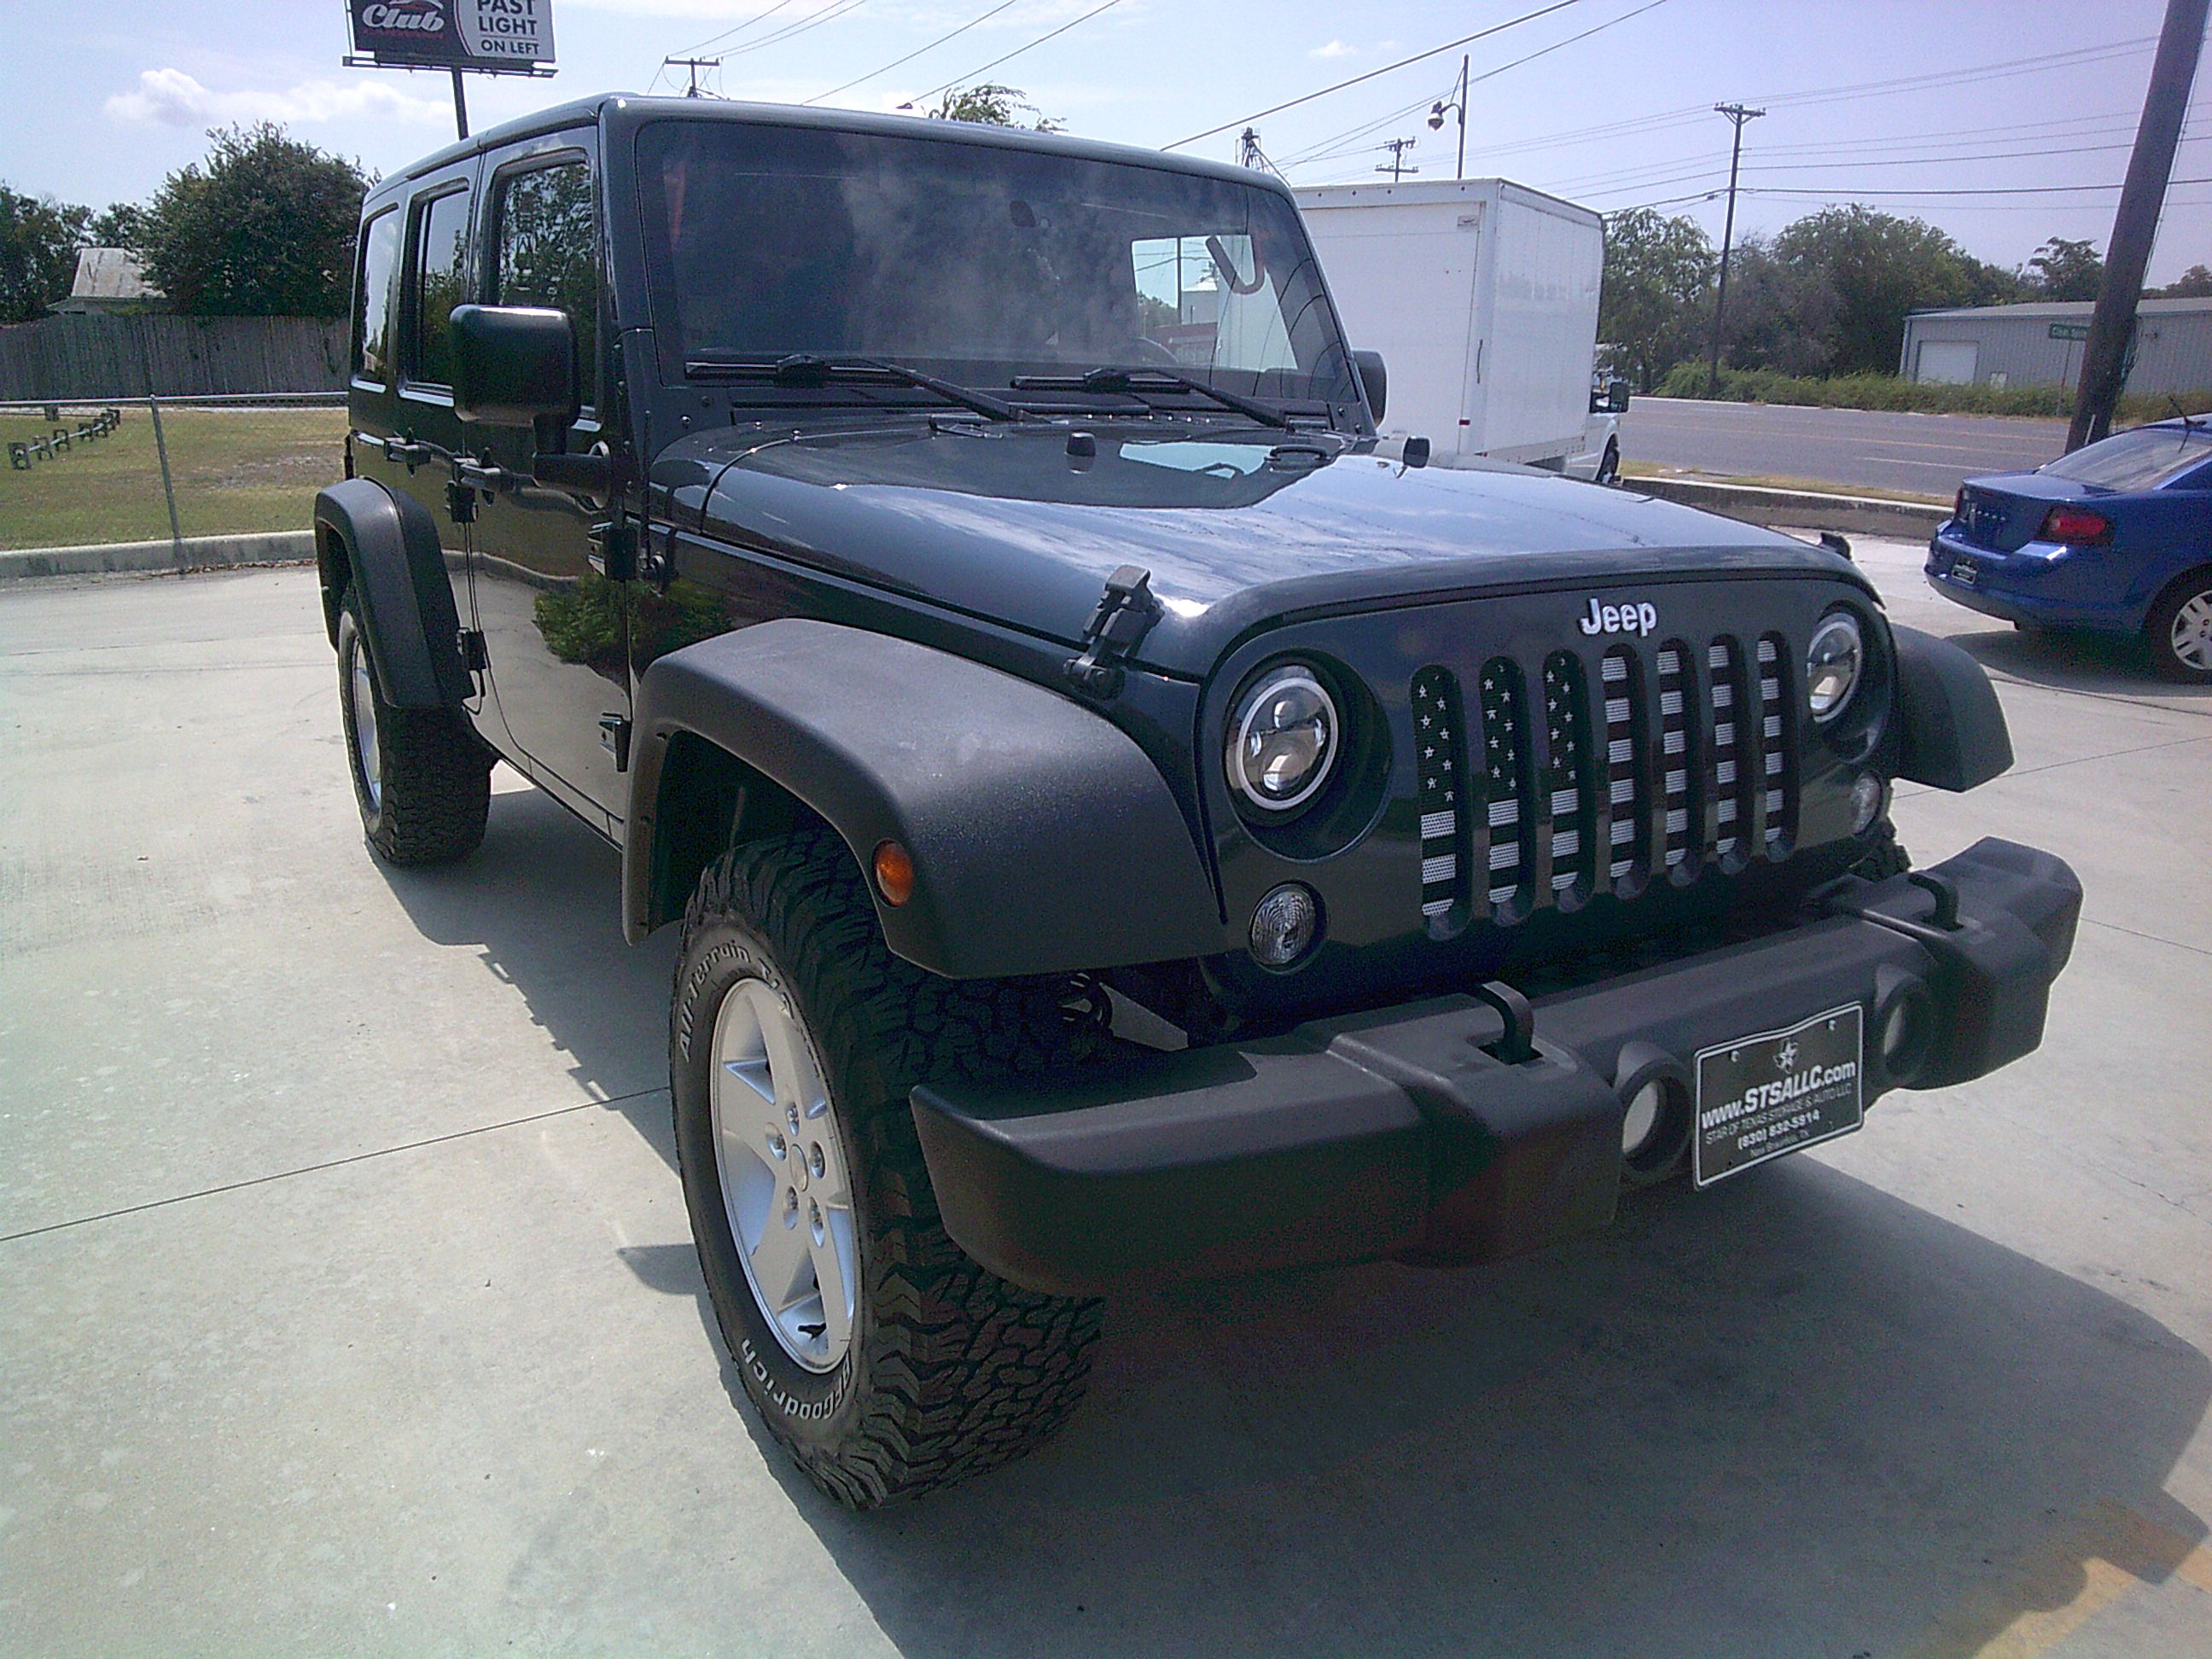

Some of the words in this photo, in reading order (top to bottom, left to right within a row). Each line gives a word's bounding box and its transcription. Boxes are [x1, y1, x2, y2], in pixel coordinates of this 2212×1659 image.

[362, 3, 445, 32] Club
[478, 0, 535, 15] PAST
[478, 15, 538, 35] LIGHT
[480, 39, 505, 53] ON
[510, 41, 539, 55] LEFT
[1580, 597, 1657, 637] Jeep
[1702, 1062, 1857, 1130] www.STSALLC.com
